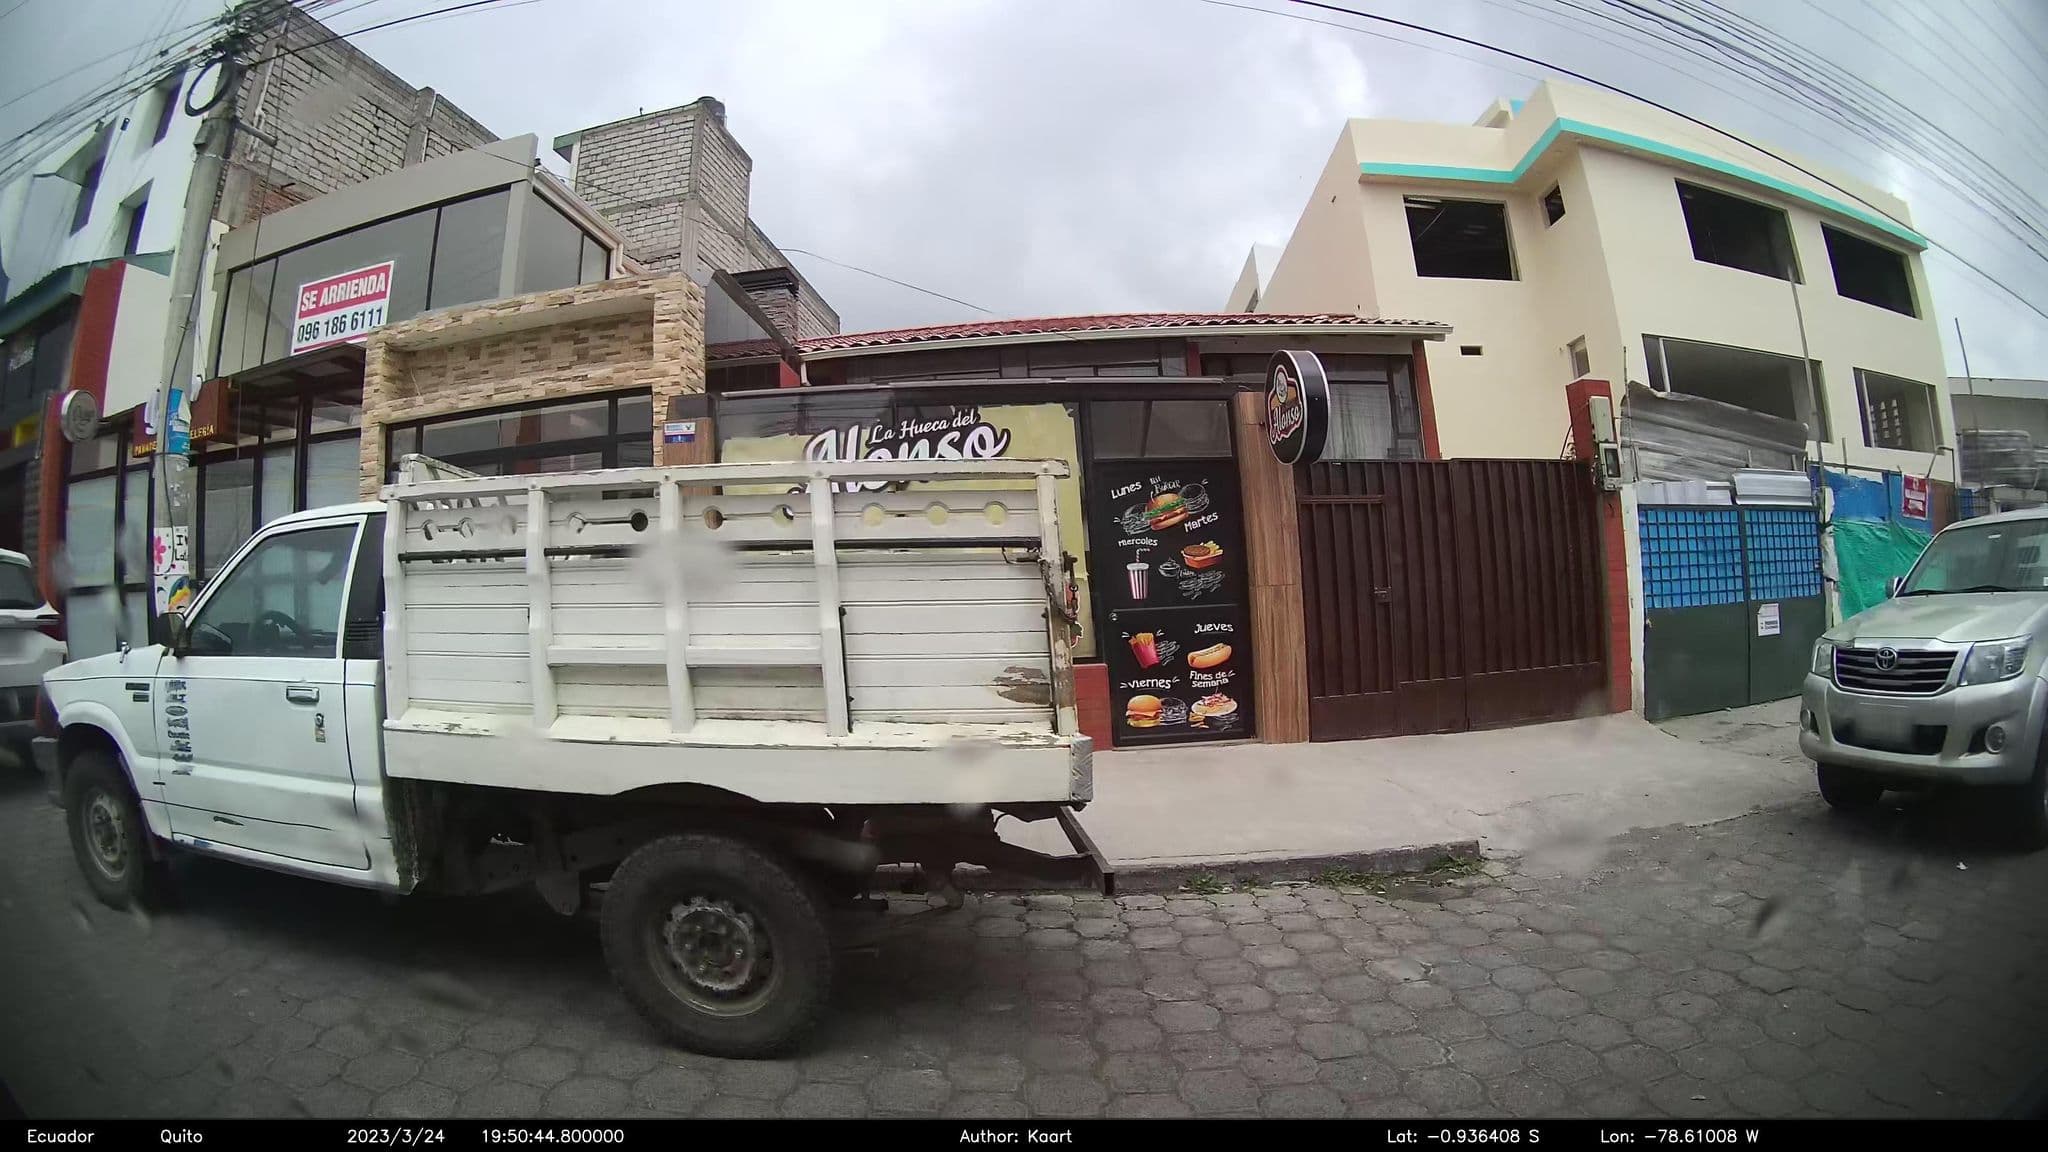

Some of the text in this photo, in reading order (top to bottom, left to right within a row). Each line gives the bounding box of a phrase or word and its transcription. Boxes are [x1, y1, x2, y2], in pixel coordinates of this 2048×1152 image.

[301, 273, 386, 312] SE ARRIENDA
[297, 306, 382, 342] 096 186 6111
[869, 409, 977, 444] La Hueca del
[1273, 405, 1300, 439] Alonso
[1110, 481, 1142, 499] Lunes
[1184, 512, 1219, 533] Martes
[1194, 623, 1234, 634] Jueves
[1215, 671, 1227, 680] de
